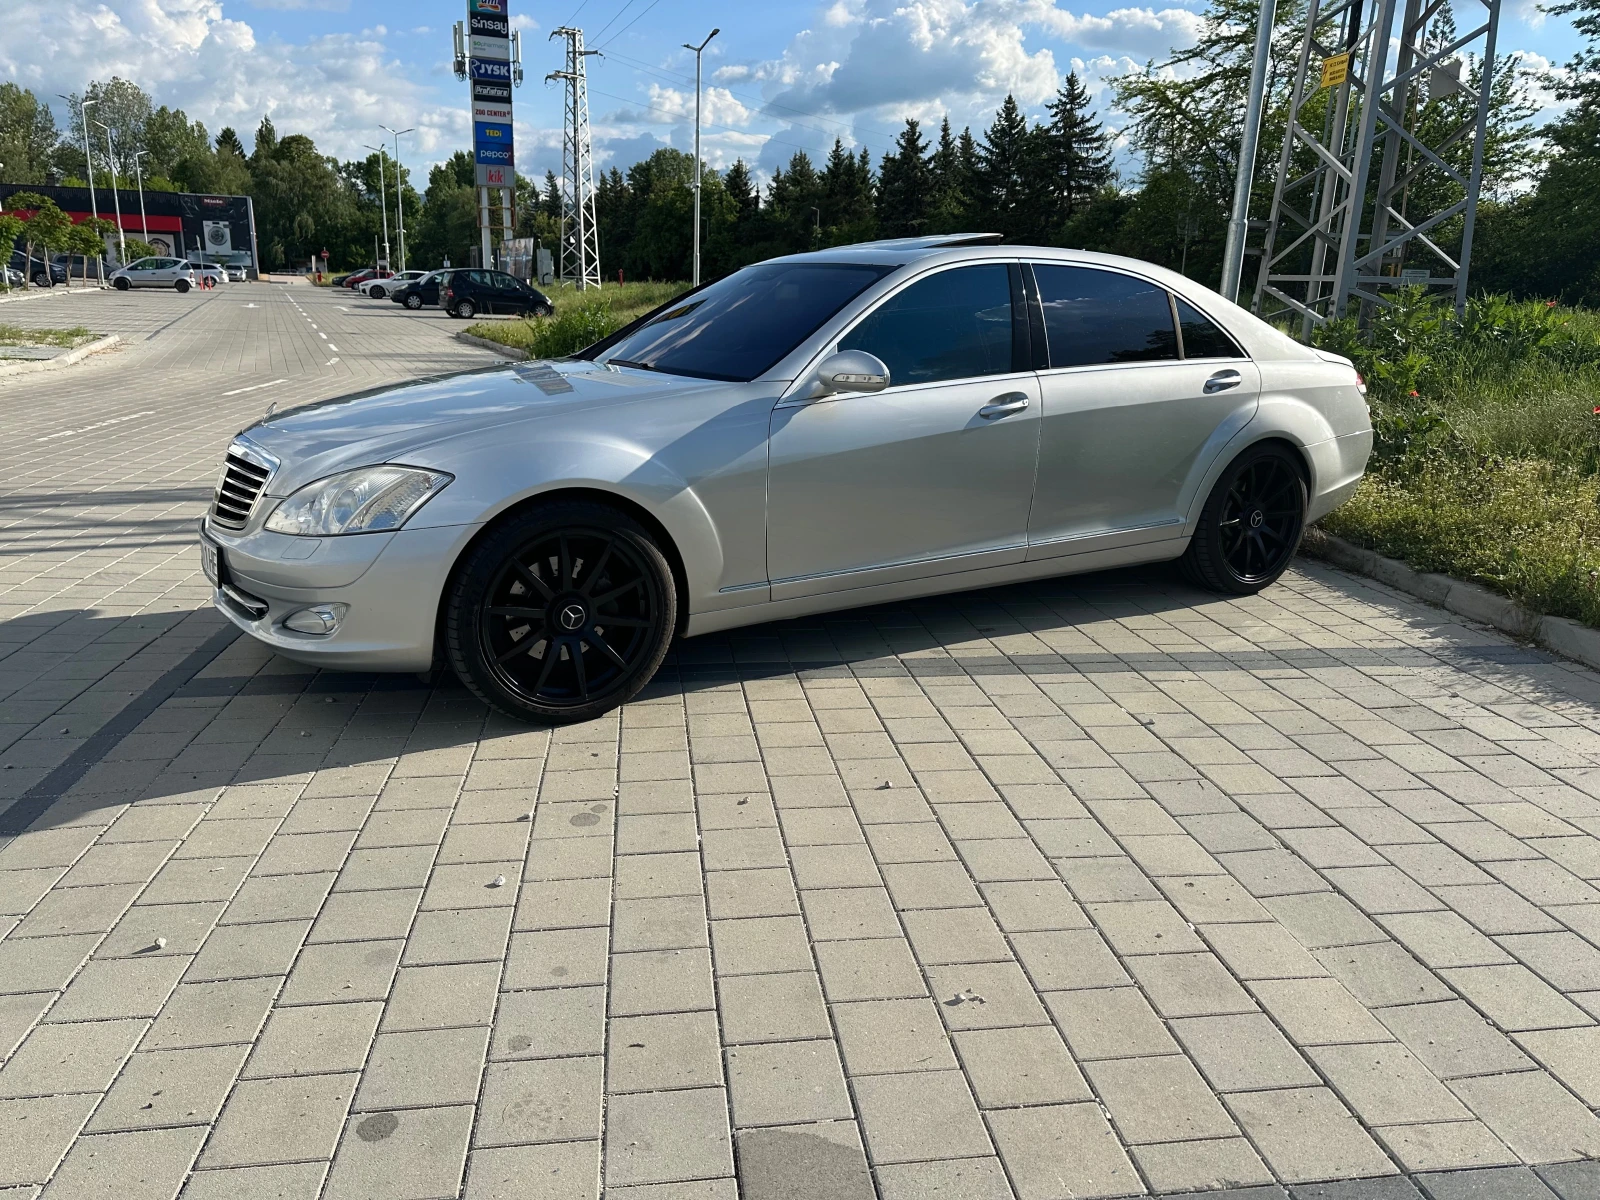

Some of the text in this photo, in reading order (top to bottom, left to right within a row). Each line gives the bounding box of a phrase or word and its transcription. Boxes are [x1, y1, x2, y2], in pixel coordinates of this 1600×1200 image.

[471, 16, 508, 34] sinsay
[479, 63, 509, 76] JYSK
[480, 150, 508, 159] pepco
